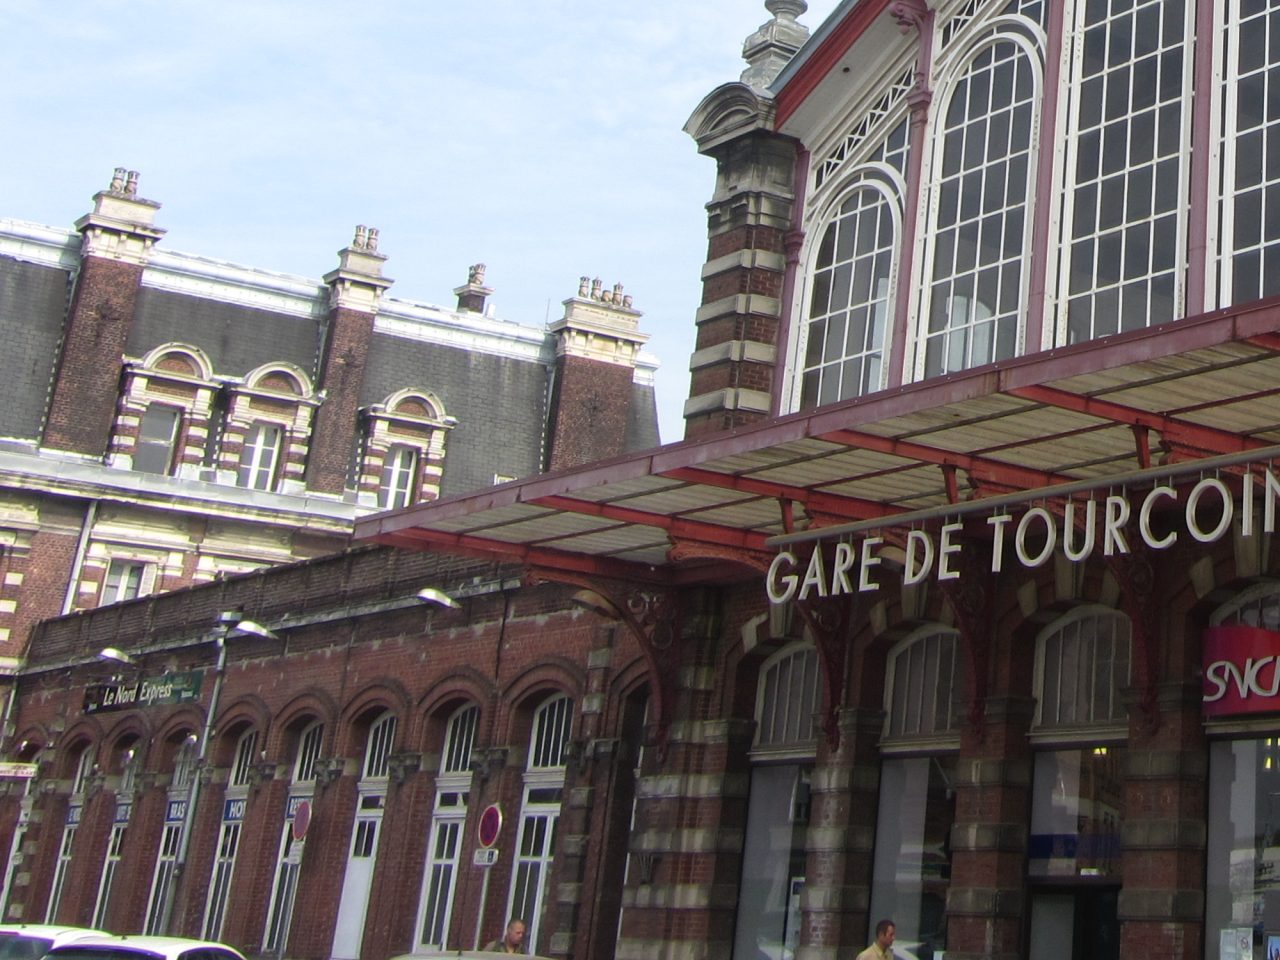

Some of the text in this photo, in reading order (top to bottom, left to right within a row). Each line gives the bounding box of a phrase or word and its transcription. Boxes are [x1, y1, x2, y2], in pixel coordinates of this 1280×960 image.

[767, 537, 884, 604] GARE
[904, 523, 964, 585] DE
[103, 681, 173, 706] Le Nord Express
